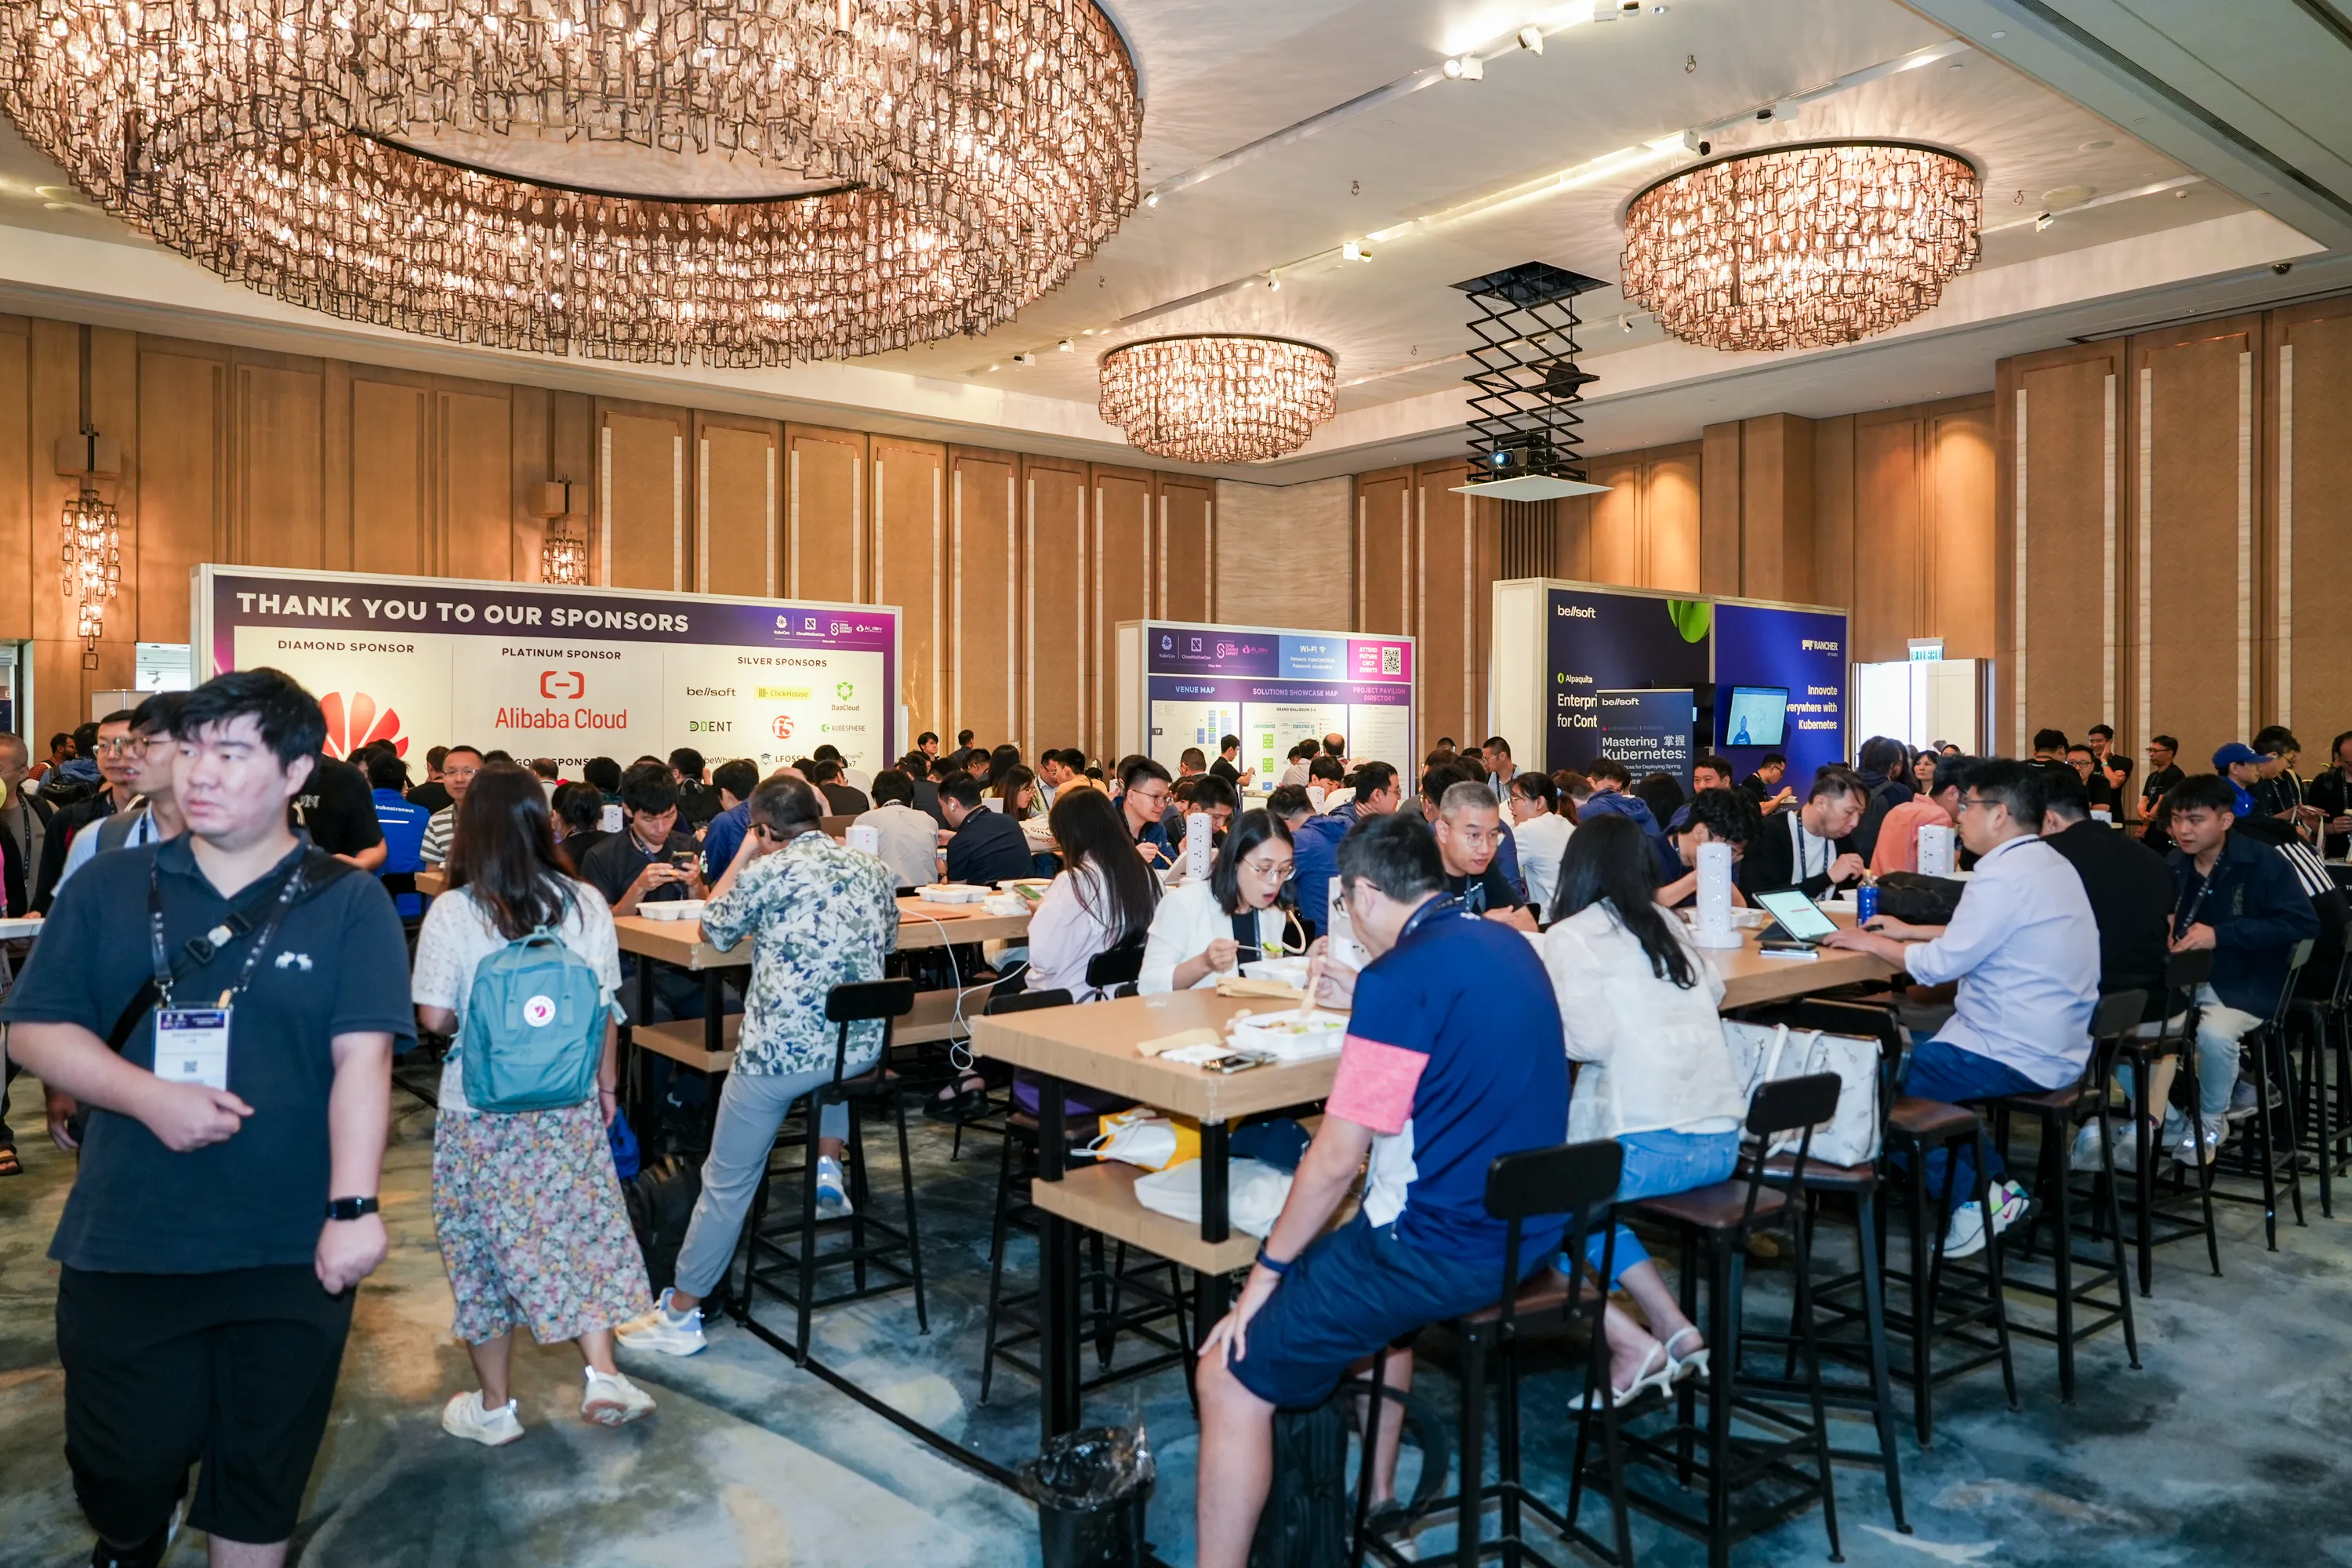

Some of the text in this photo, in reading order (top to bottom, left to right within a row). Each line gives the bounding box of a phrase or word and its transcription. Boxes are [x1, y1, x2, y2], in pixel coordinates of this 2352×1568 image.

[236, 592, 689, 633] THANK YOU TO OUR SPONSORS
[278, 640, 415, 653] DIAMOND SPONSOR
[1813, 641, 1838, 651] RANCHER
[502, 648, 621, 660] PLATINUM SPONSOR
[737, 656, 827, 667] SILVER SPONSORS
[1565, 674, 1593, 684] Alpaquita
[1252, 688, 1288, 696] SOLUTIONS
[1808, 684, 1838, 695] Innovate
[1557, 693, 1597, 710] Enterpri
[1786, 701, 1838, 715] verywhere with
[495, 707, 627, 729] Alibaba Cloud
[1557, 713, 1597, 728] for Cont
[1798, 719, 1838, 730] Kubernetes
[1602, 736, 1657, 749] Mastering
[1664, 735, 1686, 747] 掌握
[1602, 748, 1686, 760] Kubernetes:
[553, 758, 589, 767] SPONS
[375, 804, 415, 814] kubestronaut
